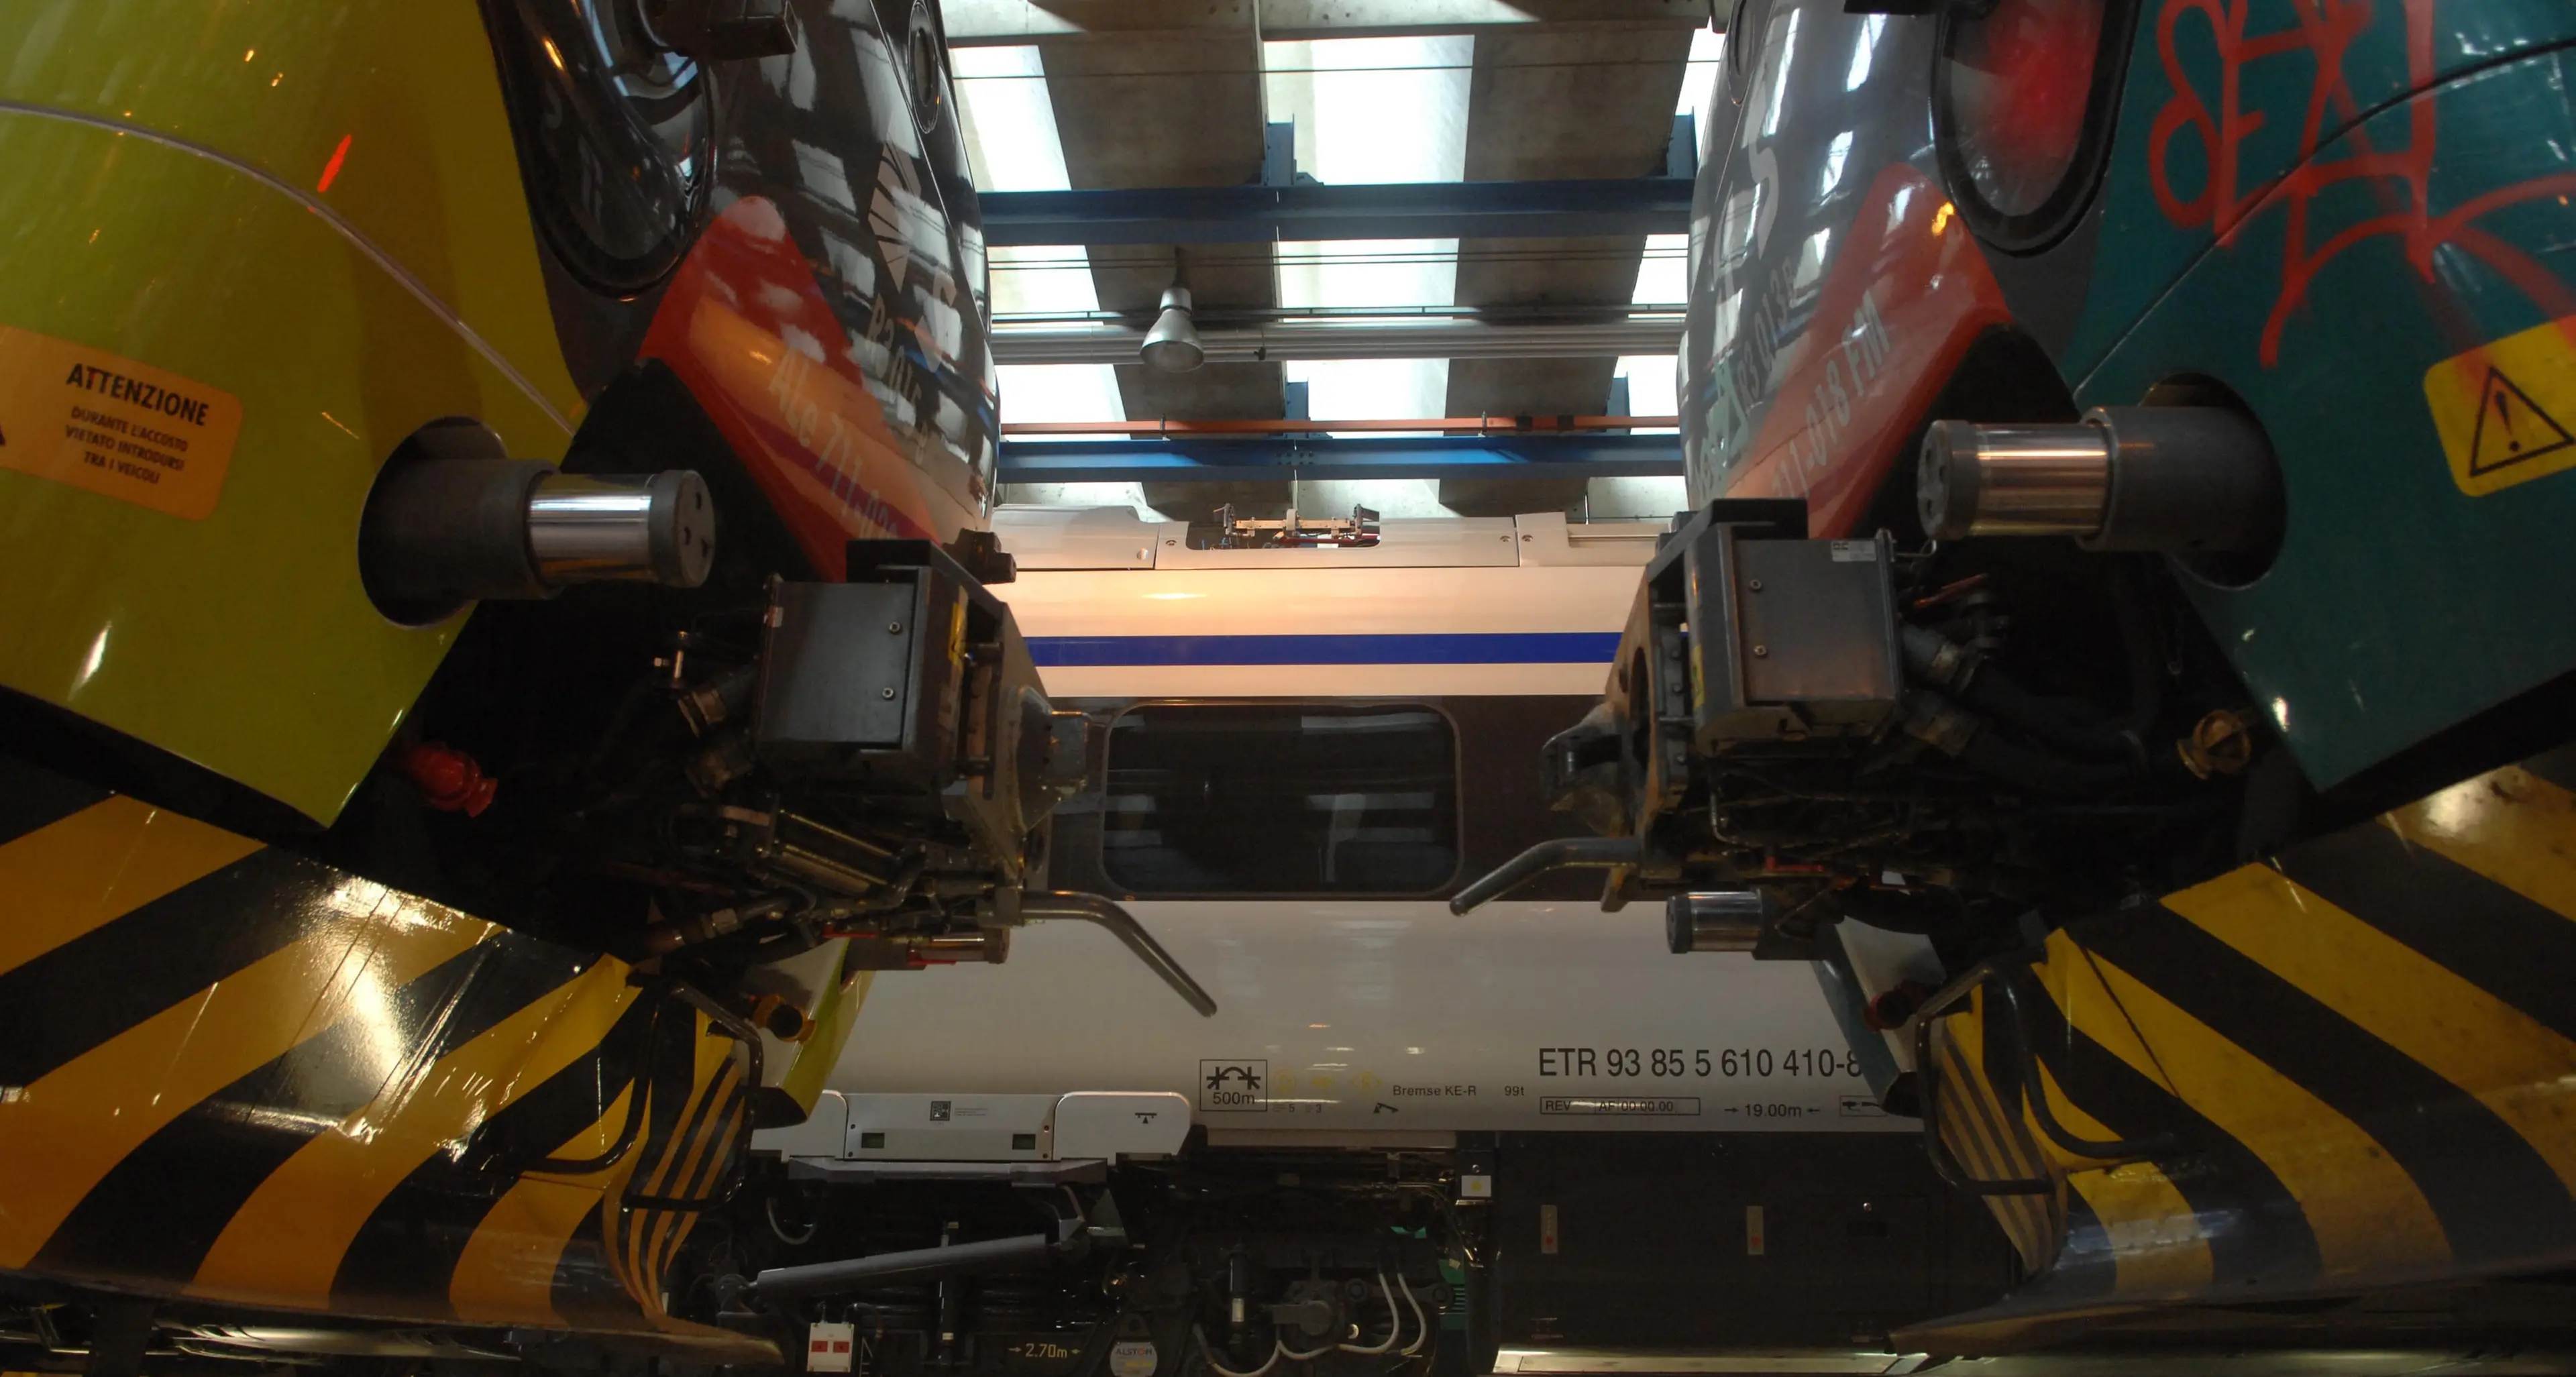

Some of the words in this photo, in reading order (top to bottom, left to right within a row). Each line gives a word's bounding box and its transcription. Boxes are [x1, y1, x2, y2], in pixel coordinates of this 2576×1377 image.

[66, 364, 209, 426] ATTENZIONE
[769, 346, 818, 447] ALe
[71, 406, 129, 434] DURANTE
[66, 424, 116, 450] VIETATO
[117, 440, 185, 471] INTRODURSI
[84, 451, 106, 467] TRA
[117, 461, 161, 485] VEICOLI
[1539, 1048, 1597, 1077] ETR
[1607, 1048, 1641, 1077] 93
[1651, 1048, 1685, 1077] 85
[1695, 1049, 1711, 1077] 5
[1721, 1048, 1773, 1077] 610
[1782, 1048, 1862, 1077] 410-8
[1213, 1091, 1255, 1105] 500m
[1393, 1085, 1441, 1097] Bremse
[1445, 1085, 1477, 1097] KE-R
[1504, 1085, 1525, 1097] 99t
[1546, 1100, 1572, 1111] REV
[1621, 1101, 1674, 1113] 00.00.00
[1745, 1104, 1802, 1117] 19.00m
[1025, 1343, 1068, 1359] 2.70m
